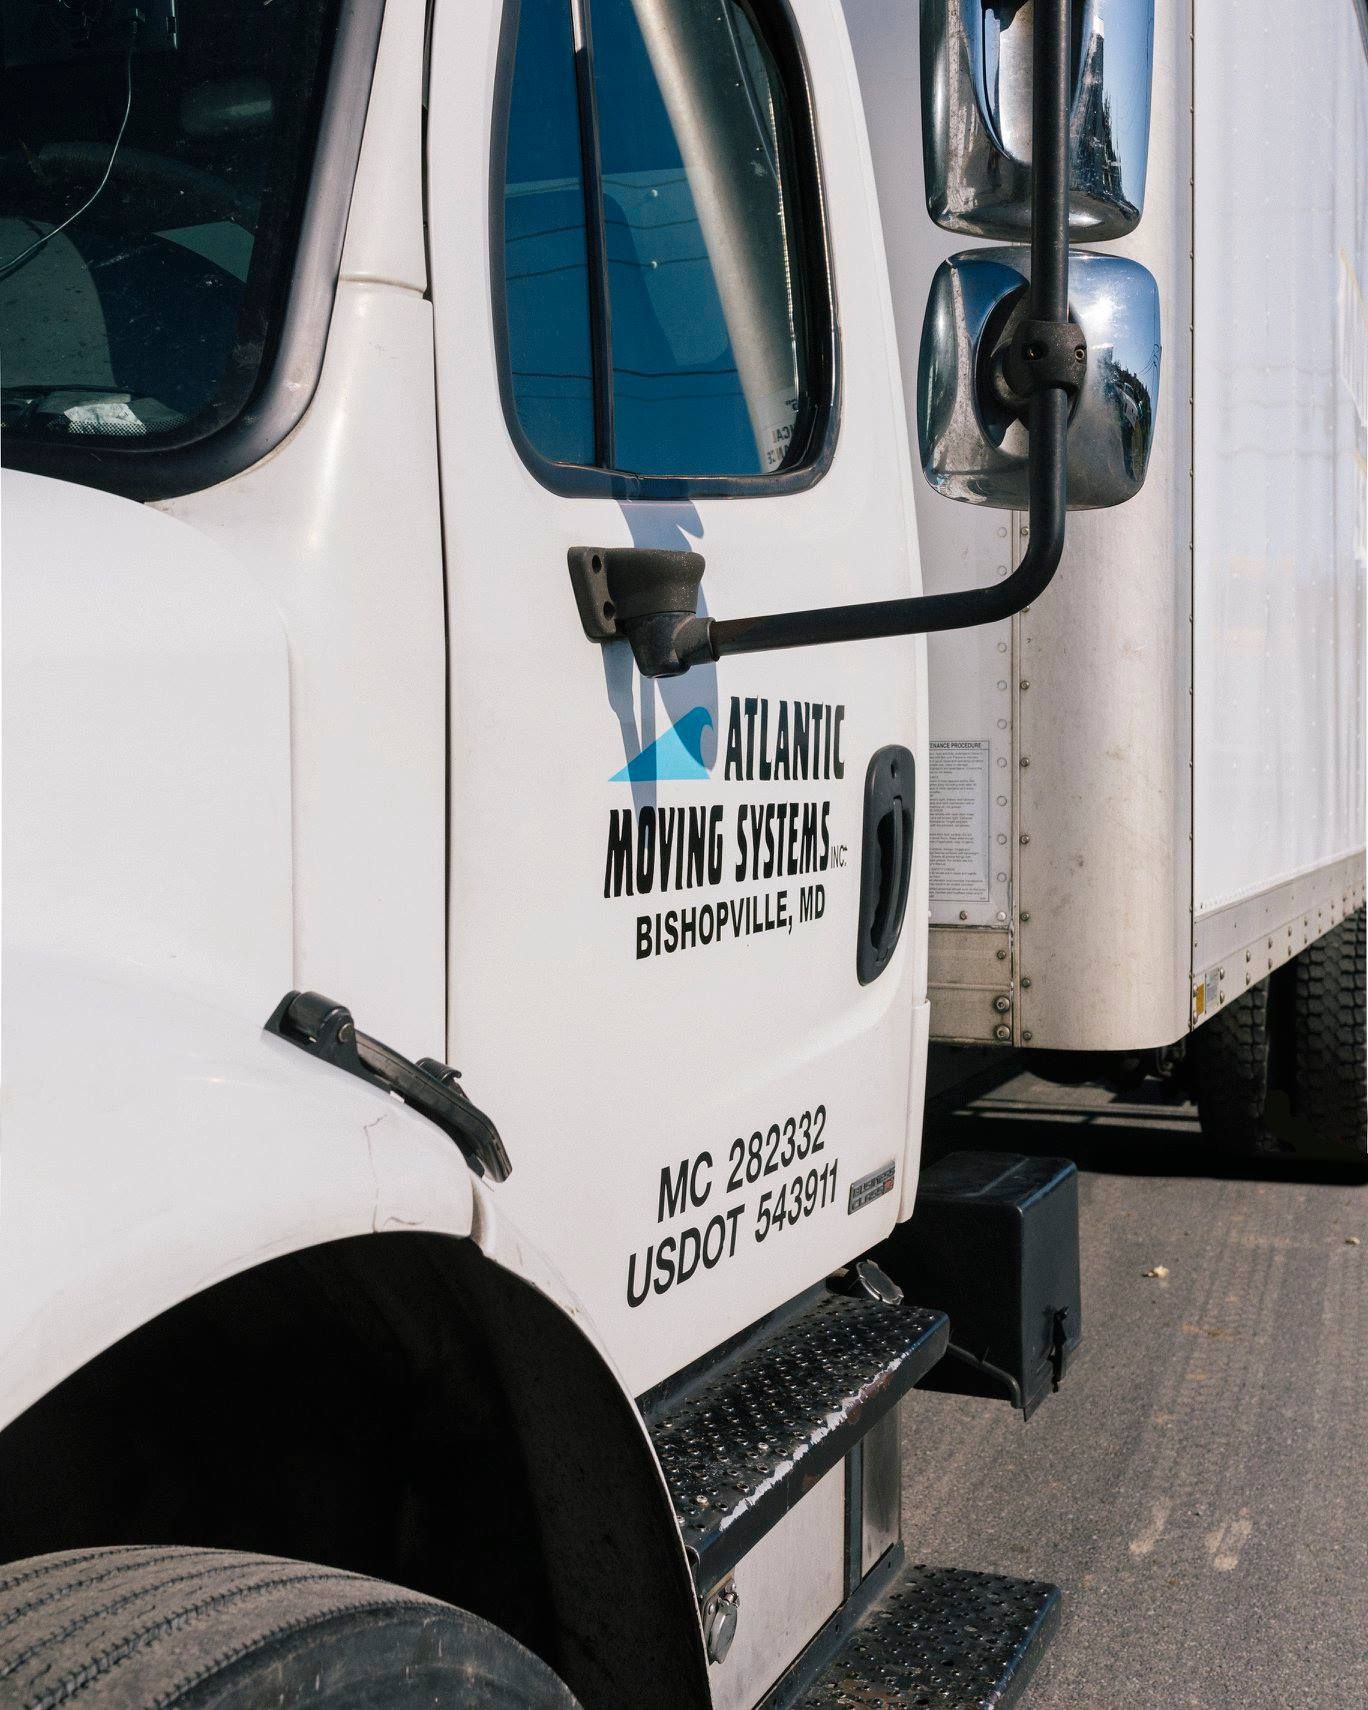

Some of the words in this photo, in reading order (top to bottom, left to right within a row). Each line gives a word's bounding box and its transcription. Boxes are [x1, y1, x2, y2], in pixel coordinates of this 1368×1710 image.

[724, 696, 845, 781] ATLANTIC
[604, 804, 724, 898] MOVING
[735, 801, 830, 882] SYSTEMS
[636, 890, 793, 960] BISHOPVILLE,
[799, 884, 825, 923] MD
[657, 1151, 713, 1223] MC
[726, 1104, 827, 1193] 282332
[626, 1204, 746, 1308] USDOT
[754, 1158, 838, 1243] 543911
